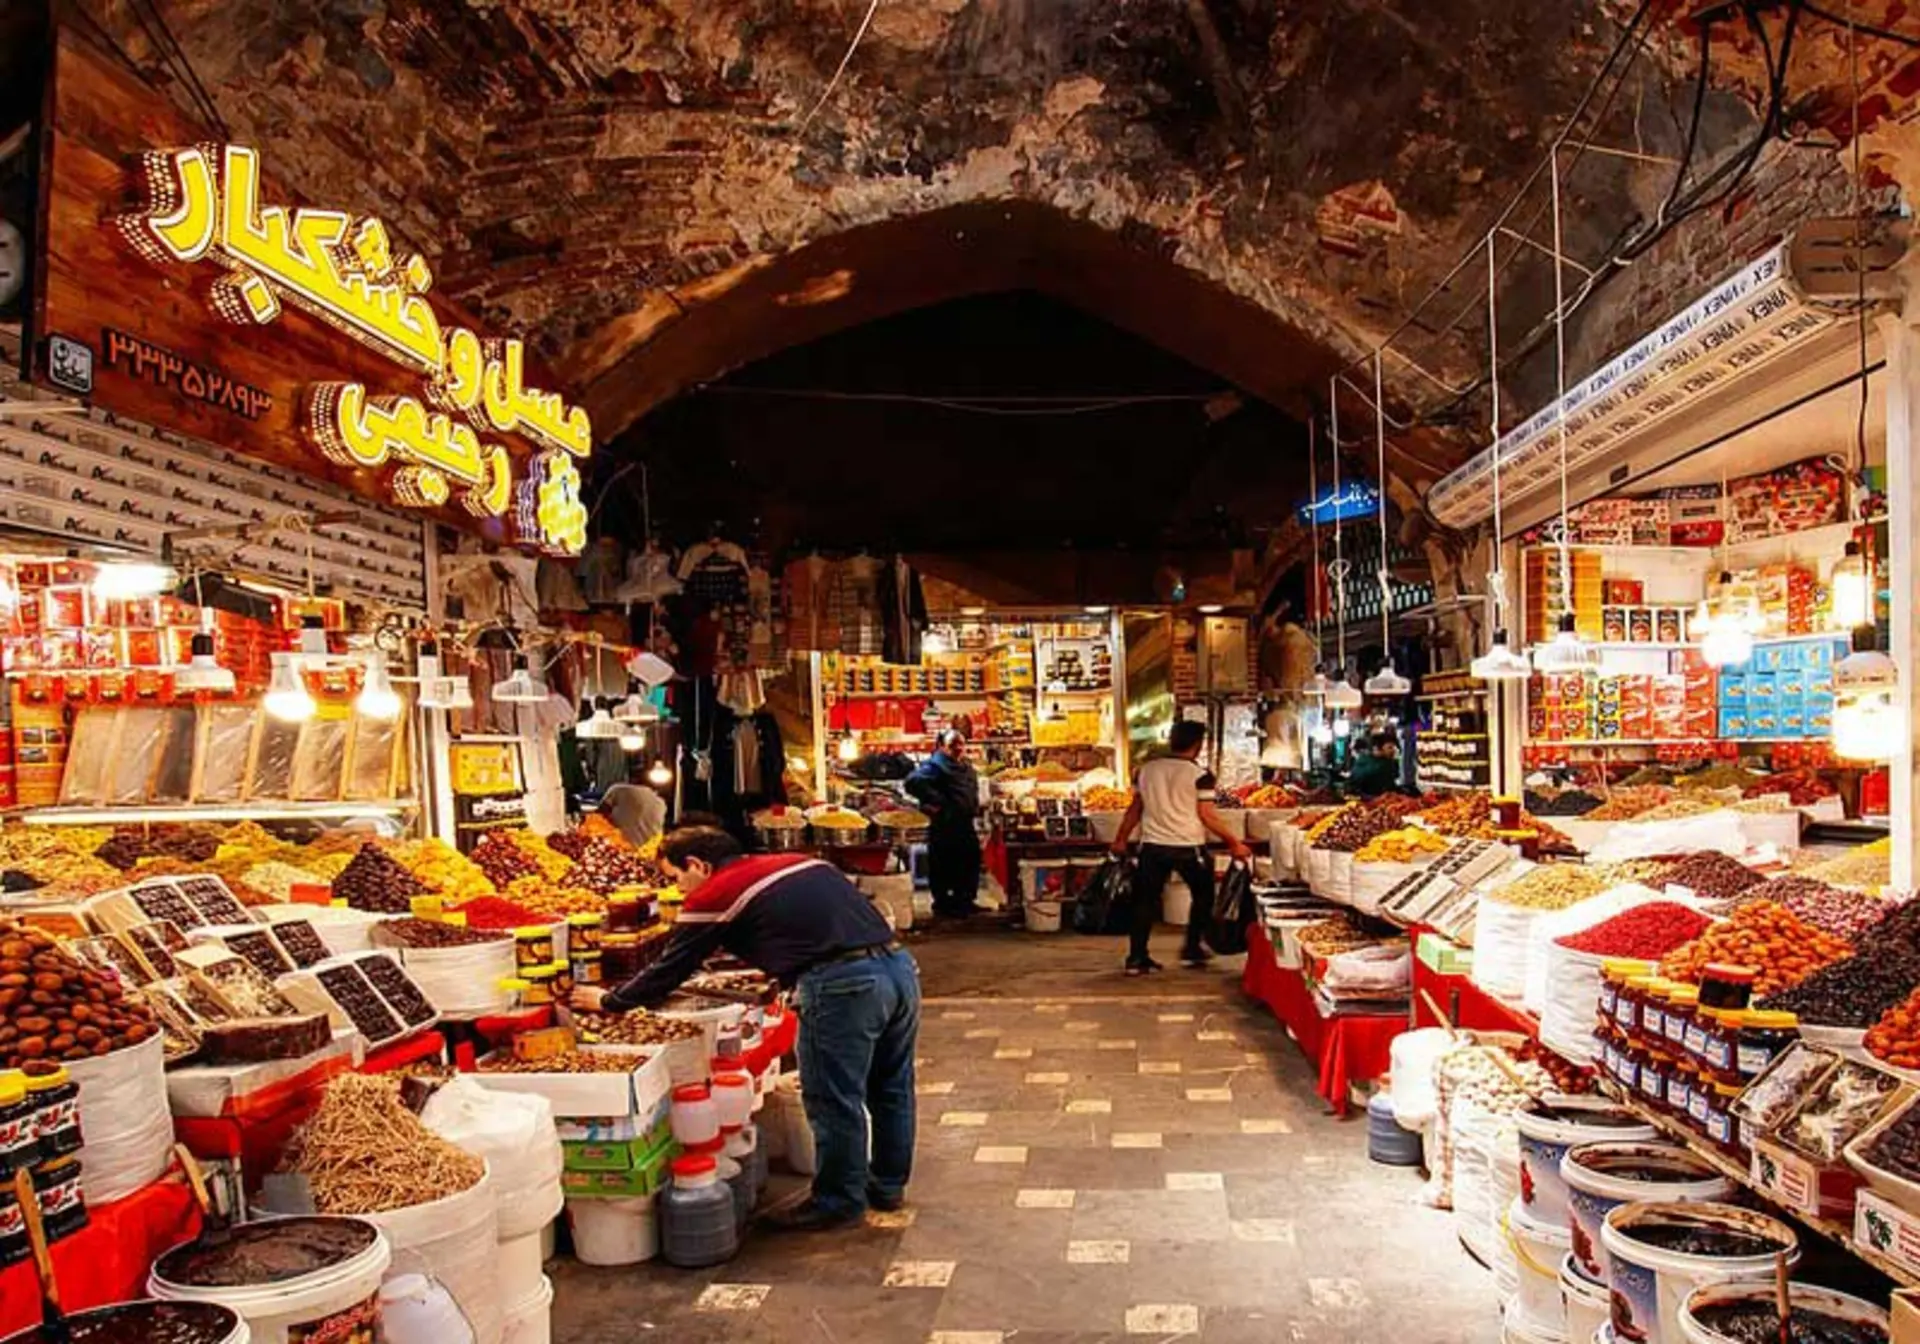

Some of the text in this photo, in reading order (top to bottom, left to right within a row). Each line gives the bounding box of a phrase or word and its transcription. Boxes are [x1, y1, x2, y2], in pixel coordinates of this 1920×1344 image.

[148, 143, 446, 370] خشکبار
[1697, 320, 1739, 352] VINEX
[1746, 288, 1791, 323] VINEX
[108, 331, 273, 419] ۳۳۳۵۲۸۹۳
[444, 326, 485, 408] و
[484, 339, 591, 457] عسل
[338, 382, 511, 516] رحیمی
